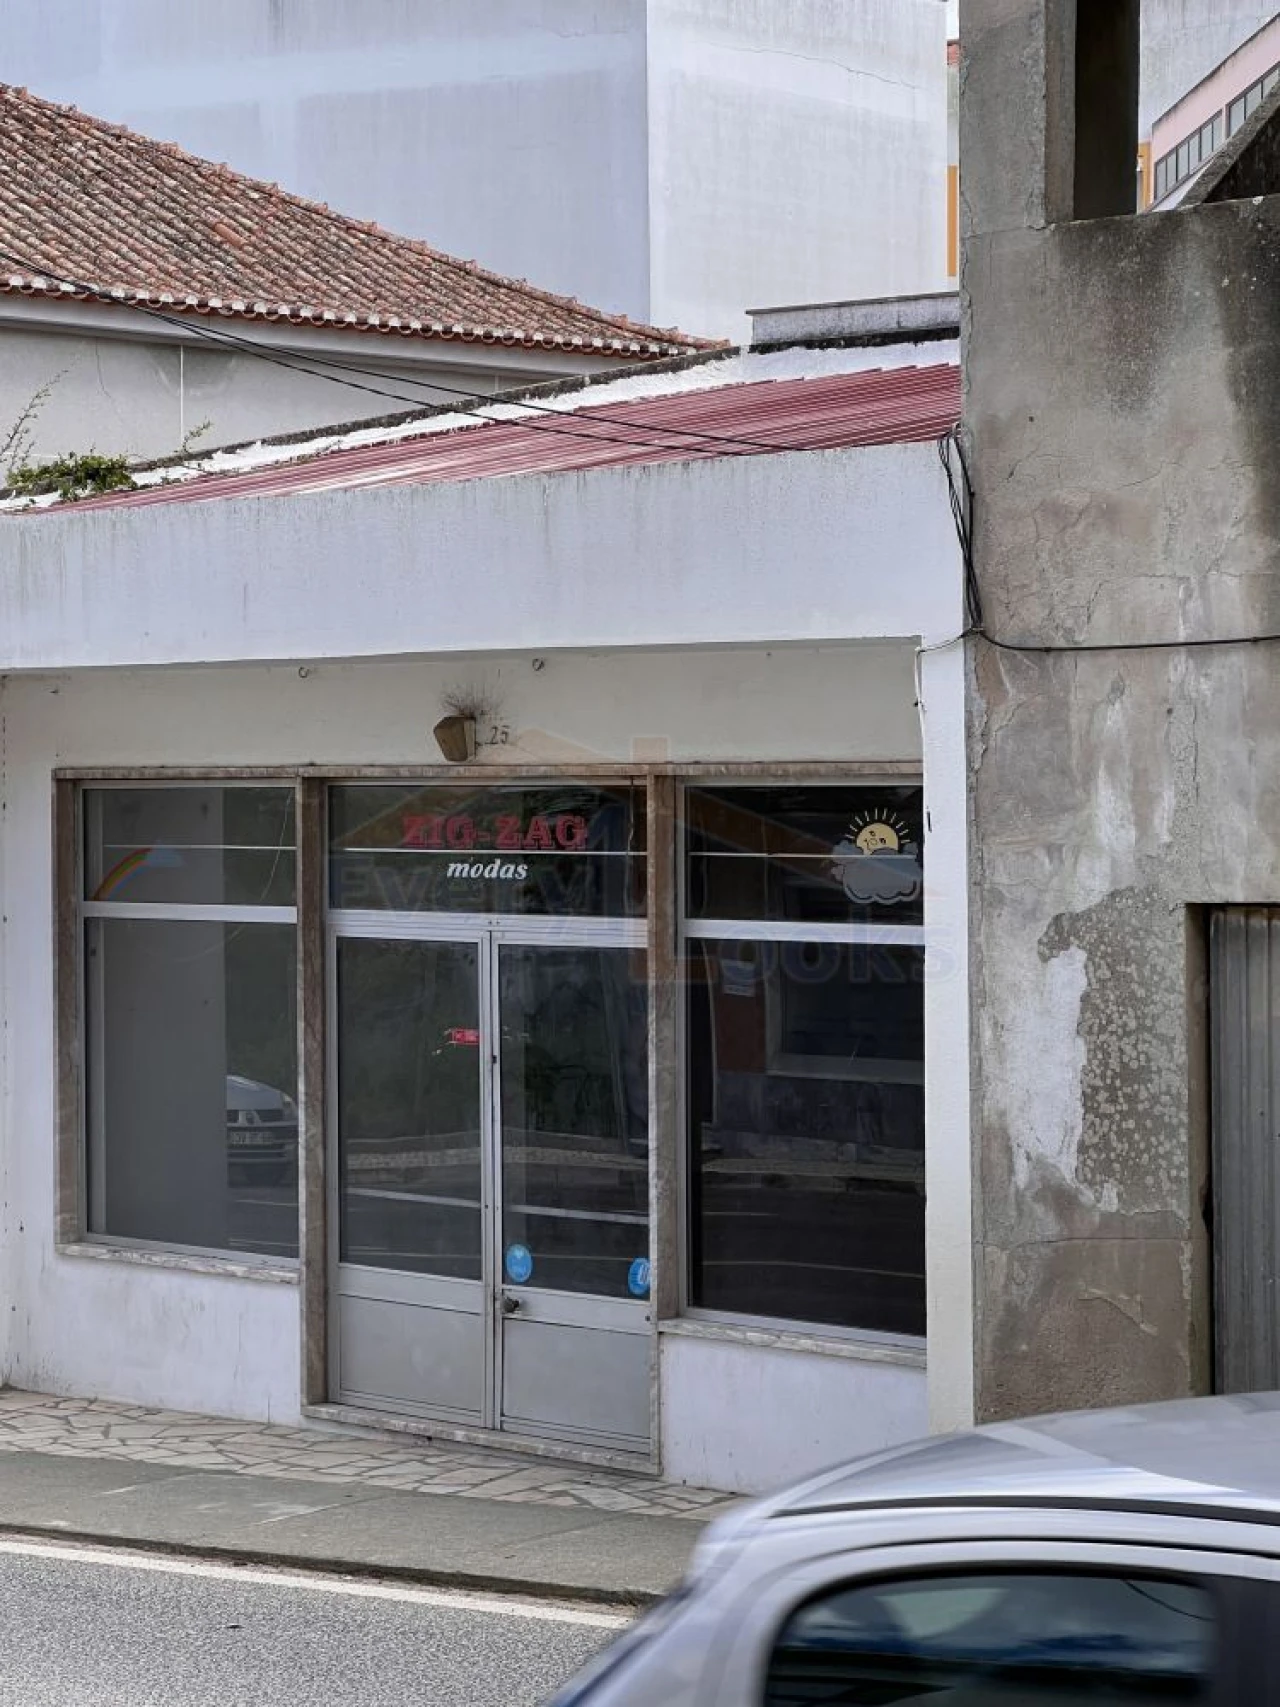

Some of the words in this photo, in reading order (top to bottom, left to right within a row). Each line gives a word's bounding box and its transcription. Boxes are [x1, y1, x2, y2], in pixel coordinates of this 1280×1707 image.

[488, 725, 511, 745] 25
[403, 813, 588, 849] ZIG-ZAG
[446, 858, 528, 880] modas
